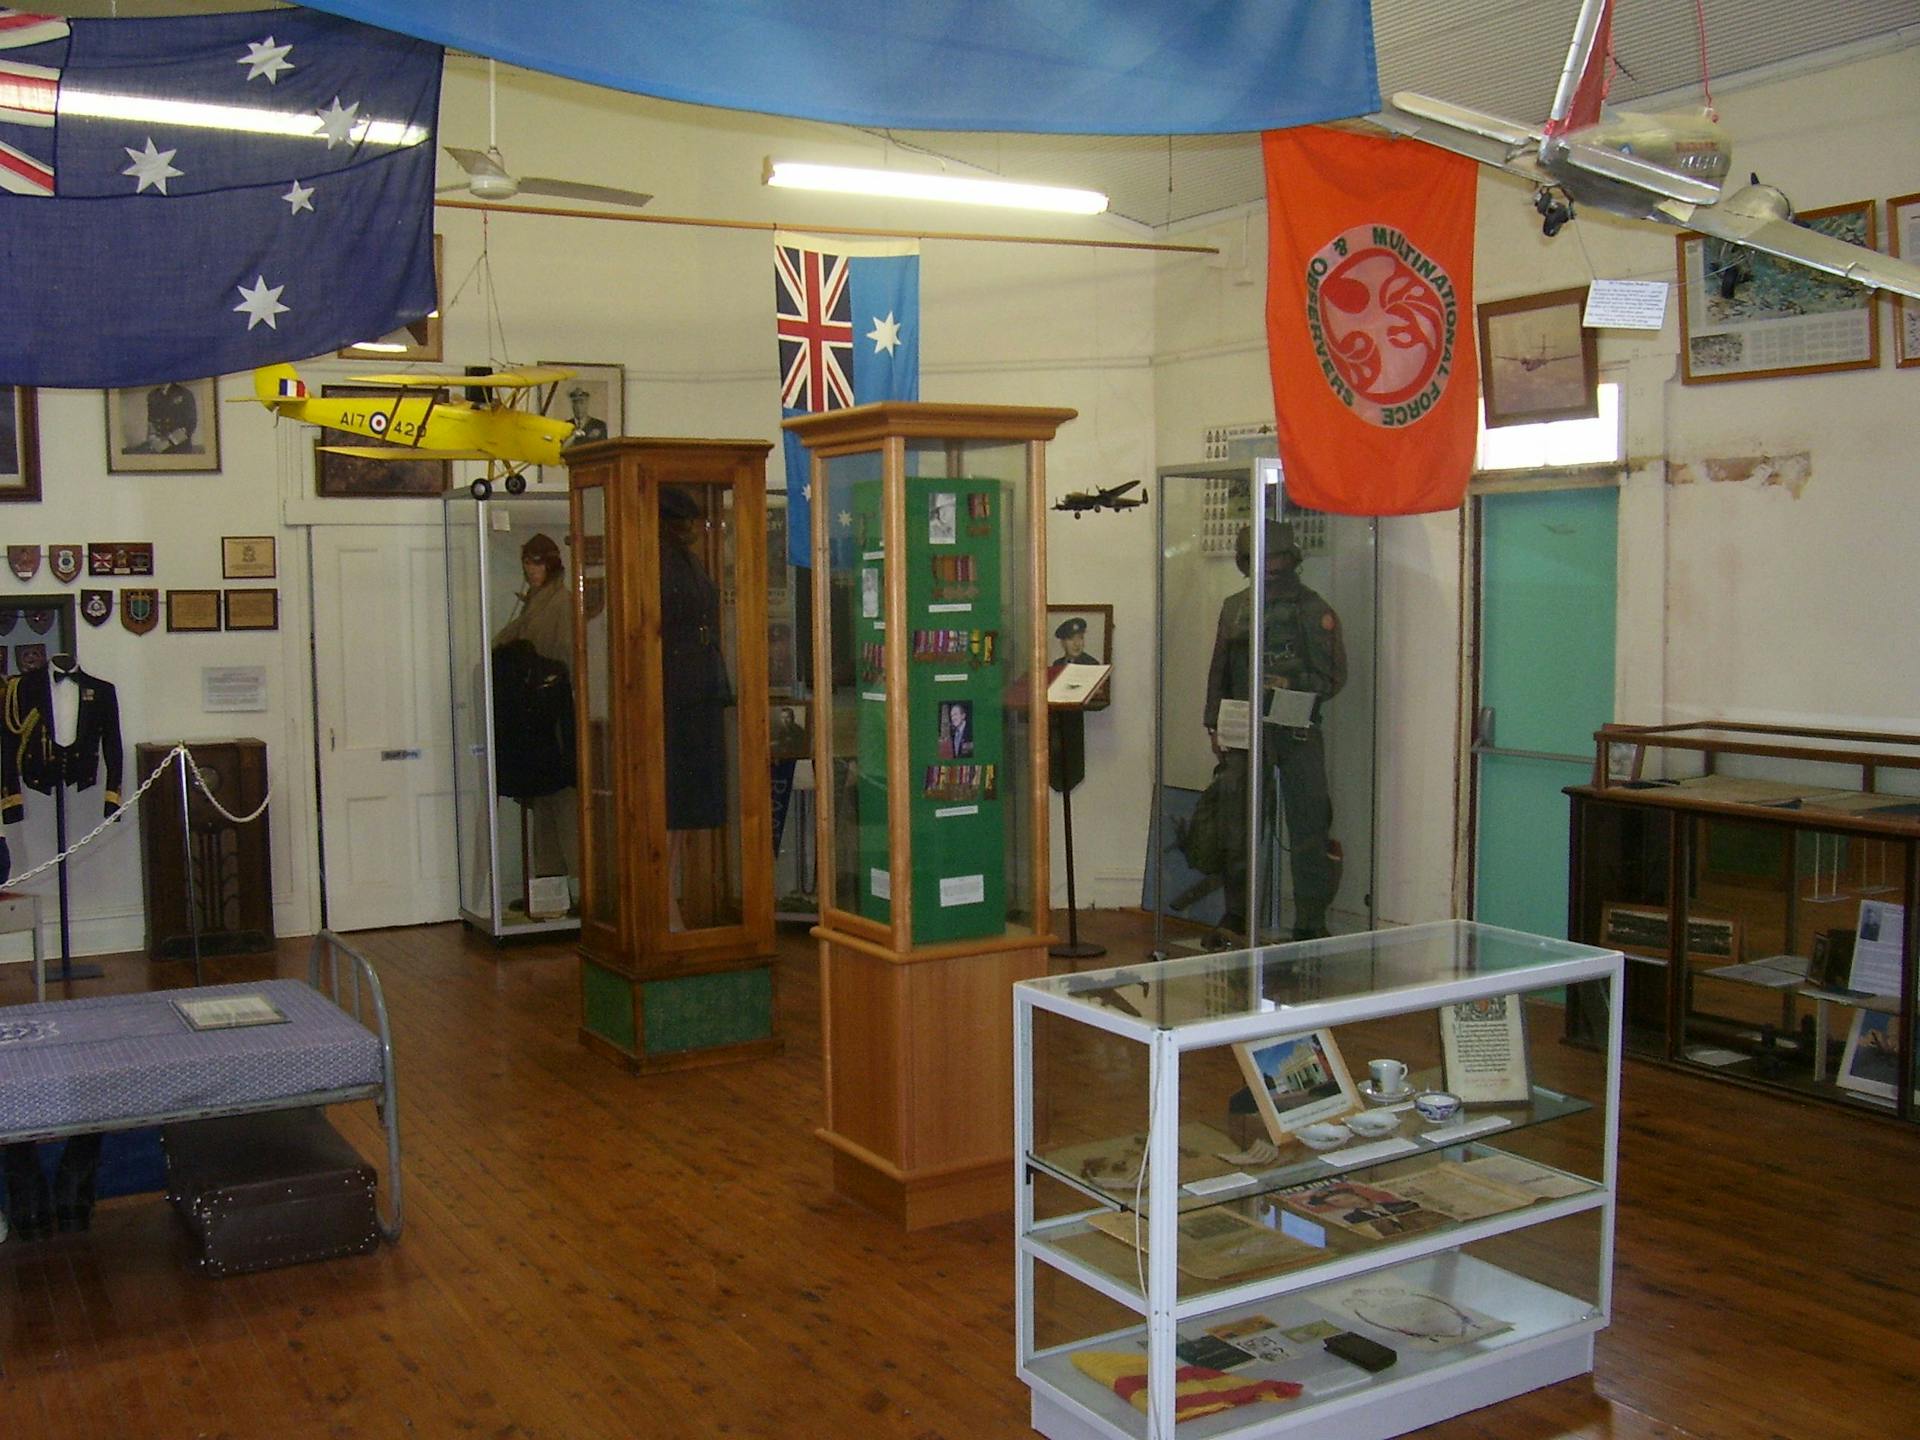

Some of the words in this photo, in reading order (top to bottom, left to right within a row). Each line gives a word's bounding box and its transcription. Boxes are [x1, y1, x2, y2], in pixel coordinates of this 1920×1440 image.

[1333, 237, 1348, 257] &
[1372, 226, 1457, 376] MULTINATIONAL
[1307, 257, 1355, 408] OBSERVERS
[340, 411, 366, 428] A17
[1382, 381, 1441, 426] FORCE
